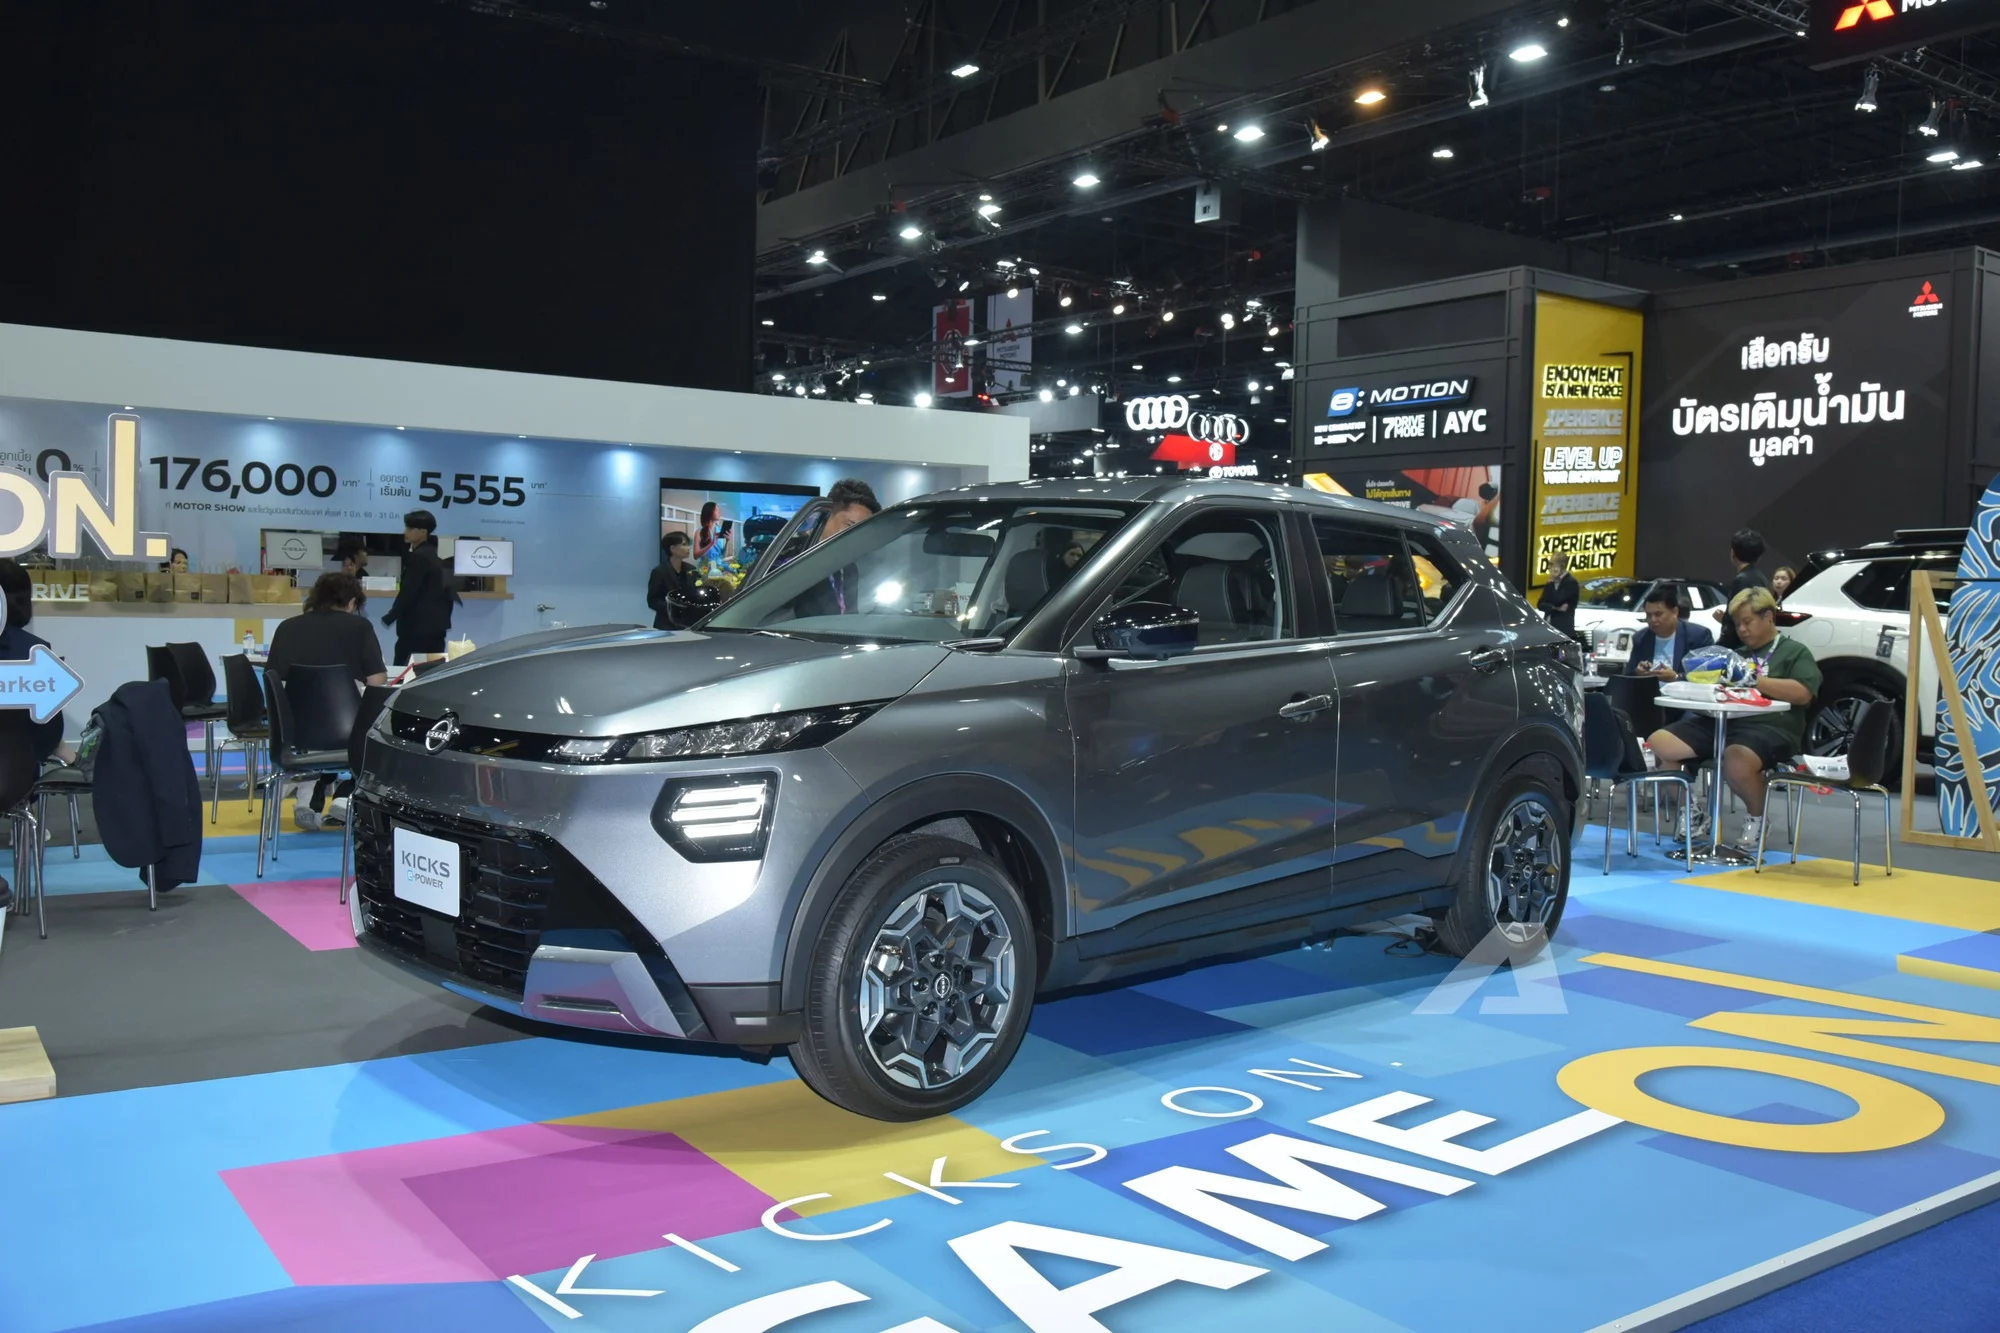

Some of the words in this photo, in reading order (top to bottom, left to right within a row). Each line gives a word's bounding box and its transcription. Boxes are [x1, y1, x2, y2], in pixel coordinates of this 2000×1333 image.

[1546, 366, 1624, 382] ENJOYMENT
[1370, 379, 1469, 404] MOTION
[1545, 385, 1555, 396] IS
[1557, 385, 1565, 396] A
[1567, 385, 1590, 396] NEW
[1592, 386, 1623, 397] FORCE
[1672, 372, 1906, 436] บัตรเติมน้ำมัน
[1382, 417, 1396, 439] 7
[1394, 414, 1425, 427] DRIVE
[1443, 408, 1487, 434] AYC
[1543, 409, 1623, 427] XPERIENCE
[1393, 426, 1425, 438] MODE
[1543, 446, 1596, 470] LEVEL
[1599, 446, 1623, 469] UP
[1749, 427, 1814, 467] มูลค่า
[36, 448, 72, 483] 0
[73, 463, 84, 472] %
[149, 455, 337, 499] 176,000
[1222, 465, 1258, 478] TOYOTA
[380, 482, 412, 497] เริ่มต้น
[419, 471, 526, 509] 5,555
[173, 502, 212, 511] MOTOR
[214, 504, 246, 512] SHOW
[1541, 532, 1618, 555] XPERIENCE
[1540, 552, 1617, 574] DABILITY
[33, 583, 89, 599] RIVE
[0, 676, 56, 693] arket
[401, 850, 450, 878] KICKS
[407, 869, 444, 889] e-POWER
[505, 1130, 1109, 1320] KICKS
